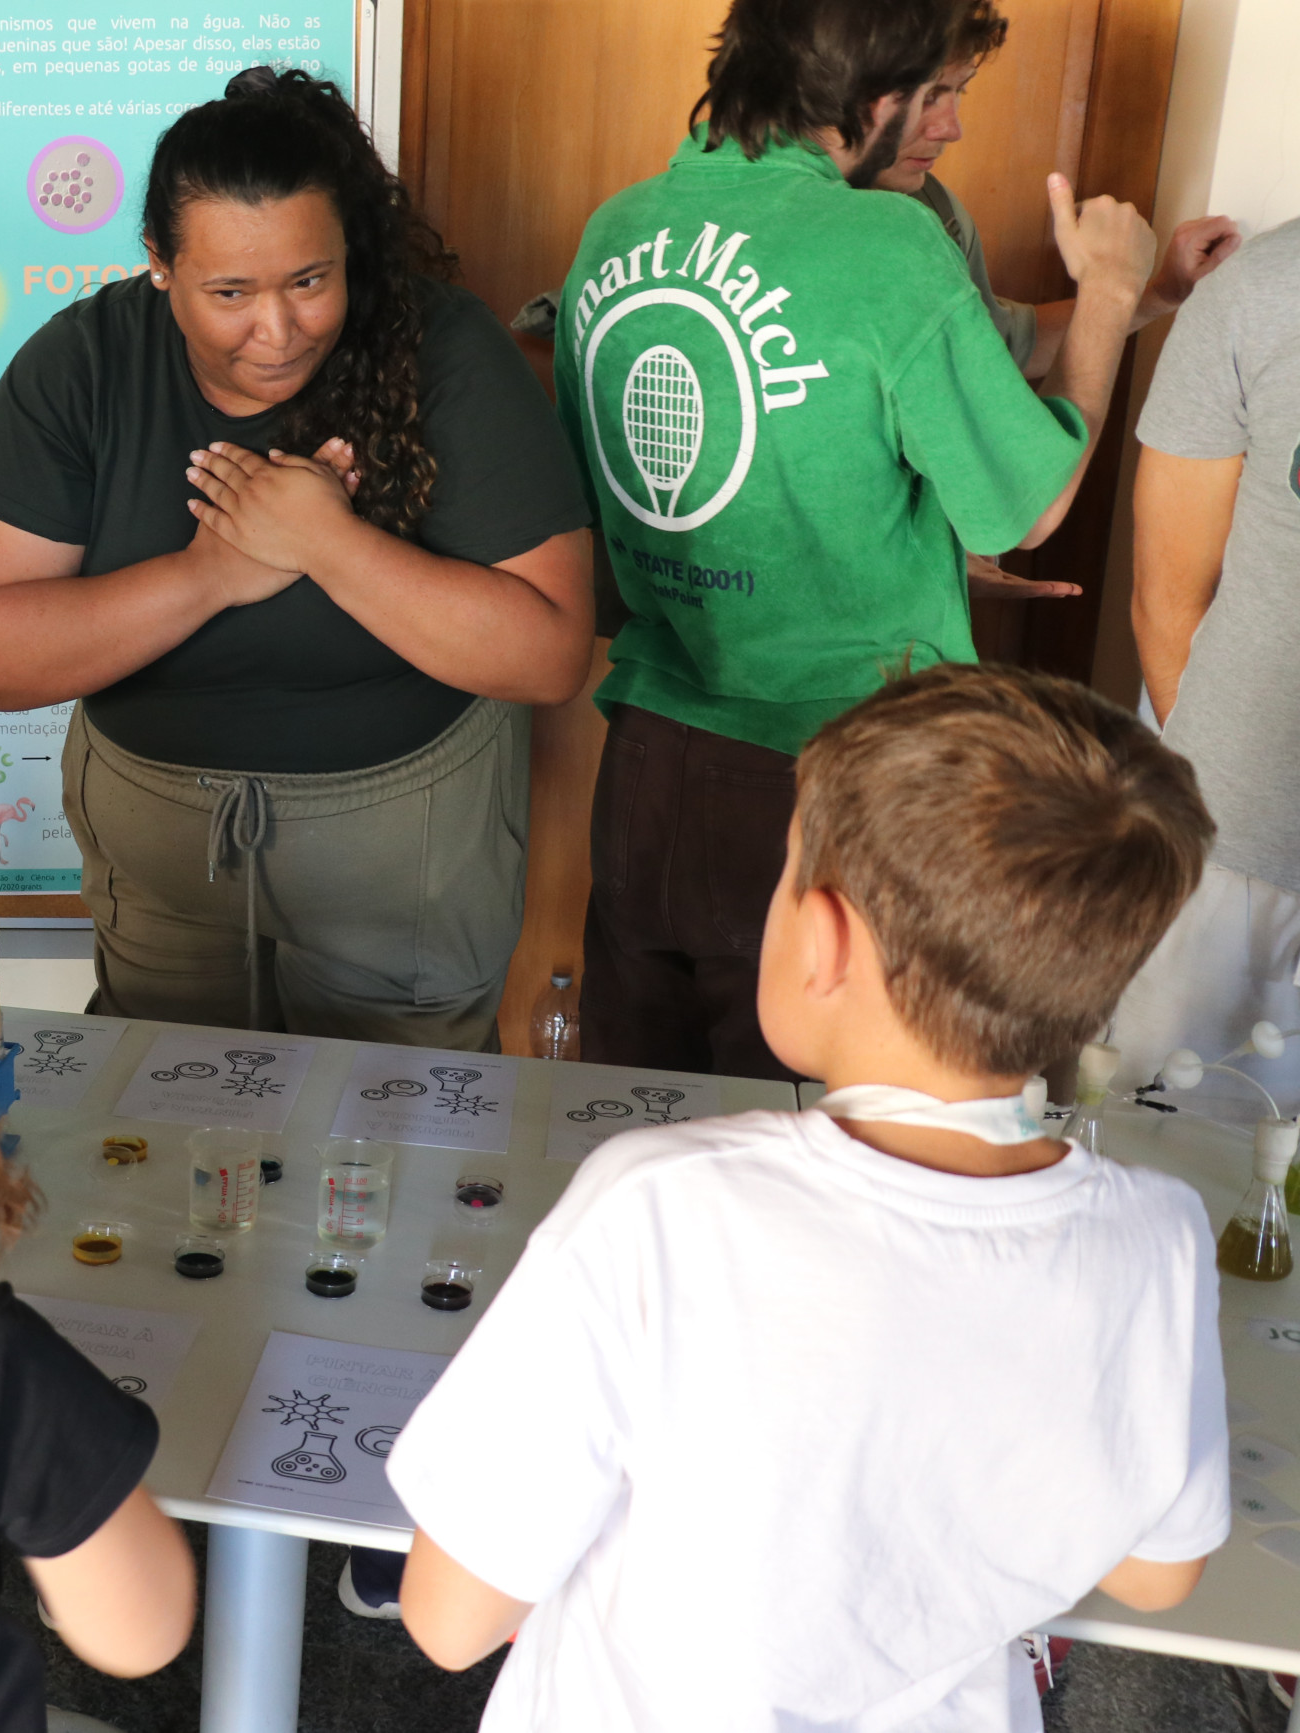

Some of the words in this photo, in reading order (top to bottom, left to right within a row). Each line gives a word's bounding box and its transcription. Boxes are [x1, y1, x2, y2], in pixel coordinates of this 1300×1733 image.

[67, 18, 96, 33] que
[111, 16, 156, 30] vivem
[170, 17, 189, 29] na
[203, 14, 245, 32] água.
[259, 14, 290, 29] Não
[304, 16, 320, 29] as
[62, 39, 91, 55] que
[97, 36, 128, 51] são!
[133, 36, 188, 54] Apesar
[193, 35, 236, 52] disso,
[242, 34, 272, 50] elas
[278, 35, 320, 50] estão
[13, 60, 37, 74] em
[45, 59, 120, 77] pequenas
[128, 57, 171, 76] gotas
[178, 56, 198, 72] de
[205, 56, 242, 74] água
[301, 58, 320, 71] no
[75, 103, 84, 115] e
[88, 100, 114, 115] até
[117, 99, 162, 114] várias
[165, 103, 201, 114] cor
[676, 221, 830, 414] Match
[632, 549, 684, 582] STATE
[687, 565, 755, 597] (2001)
[30, 873, 55, 881] Ciência
[21, 884, 42, 892] grants
[306, 1354, 414, 1381] PINTAR
